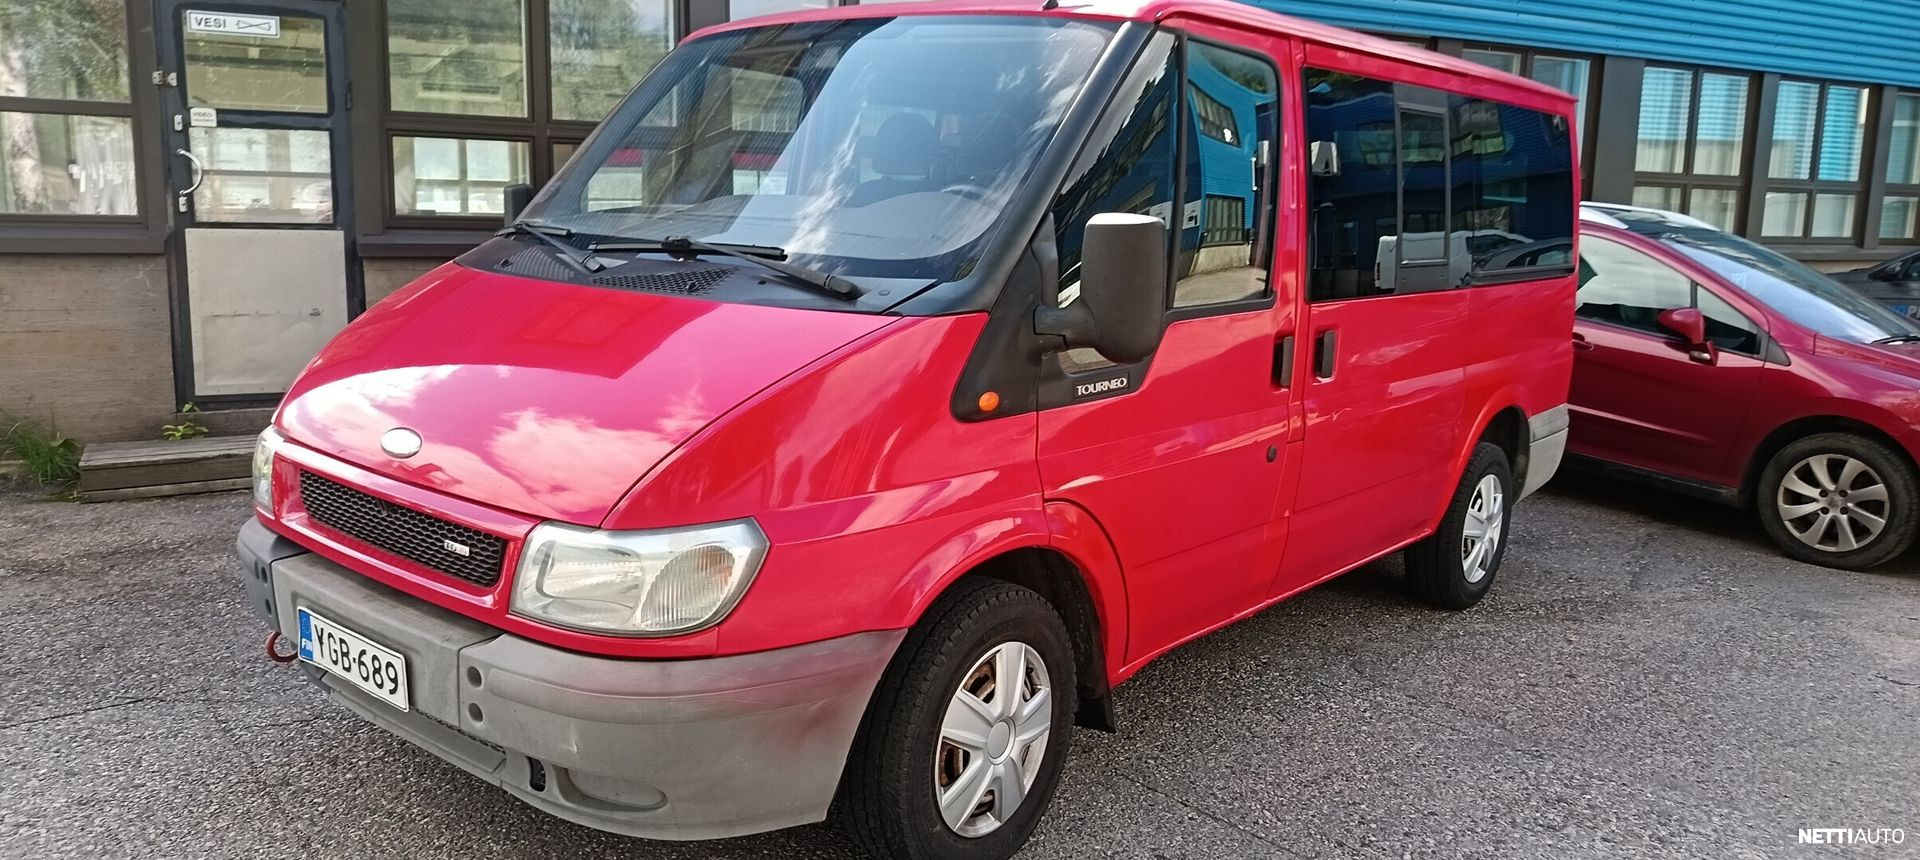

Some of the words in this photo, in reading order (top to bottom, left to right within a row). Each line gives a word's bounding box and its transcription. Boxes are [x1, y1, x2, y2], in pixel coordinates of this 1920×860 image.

[194, 17, 227, 28] VESI
[1076, 377, 1128, 396] TOURNEO
[314, 623, 399, 695] YGB-689
